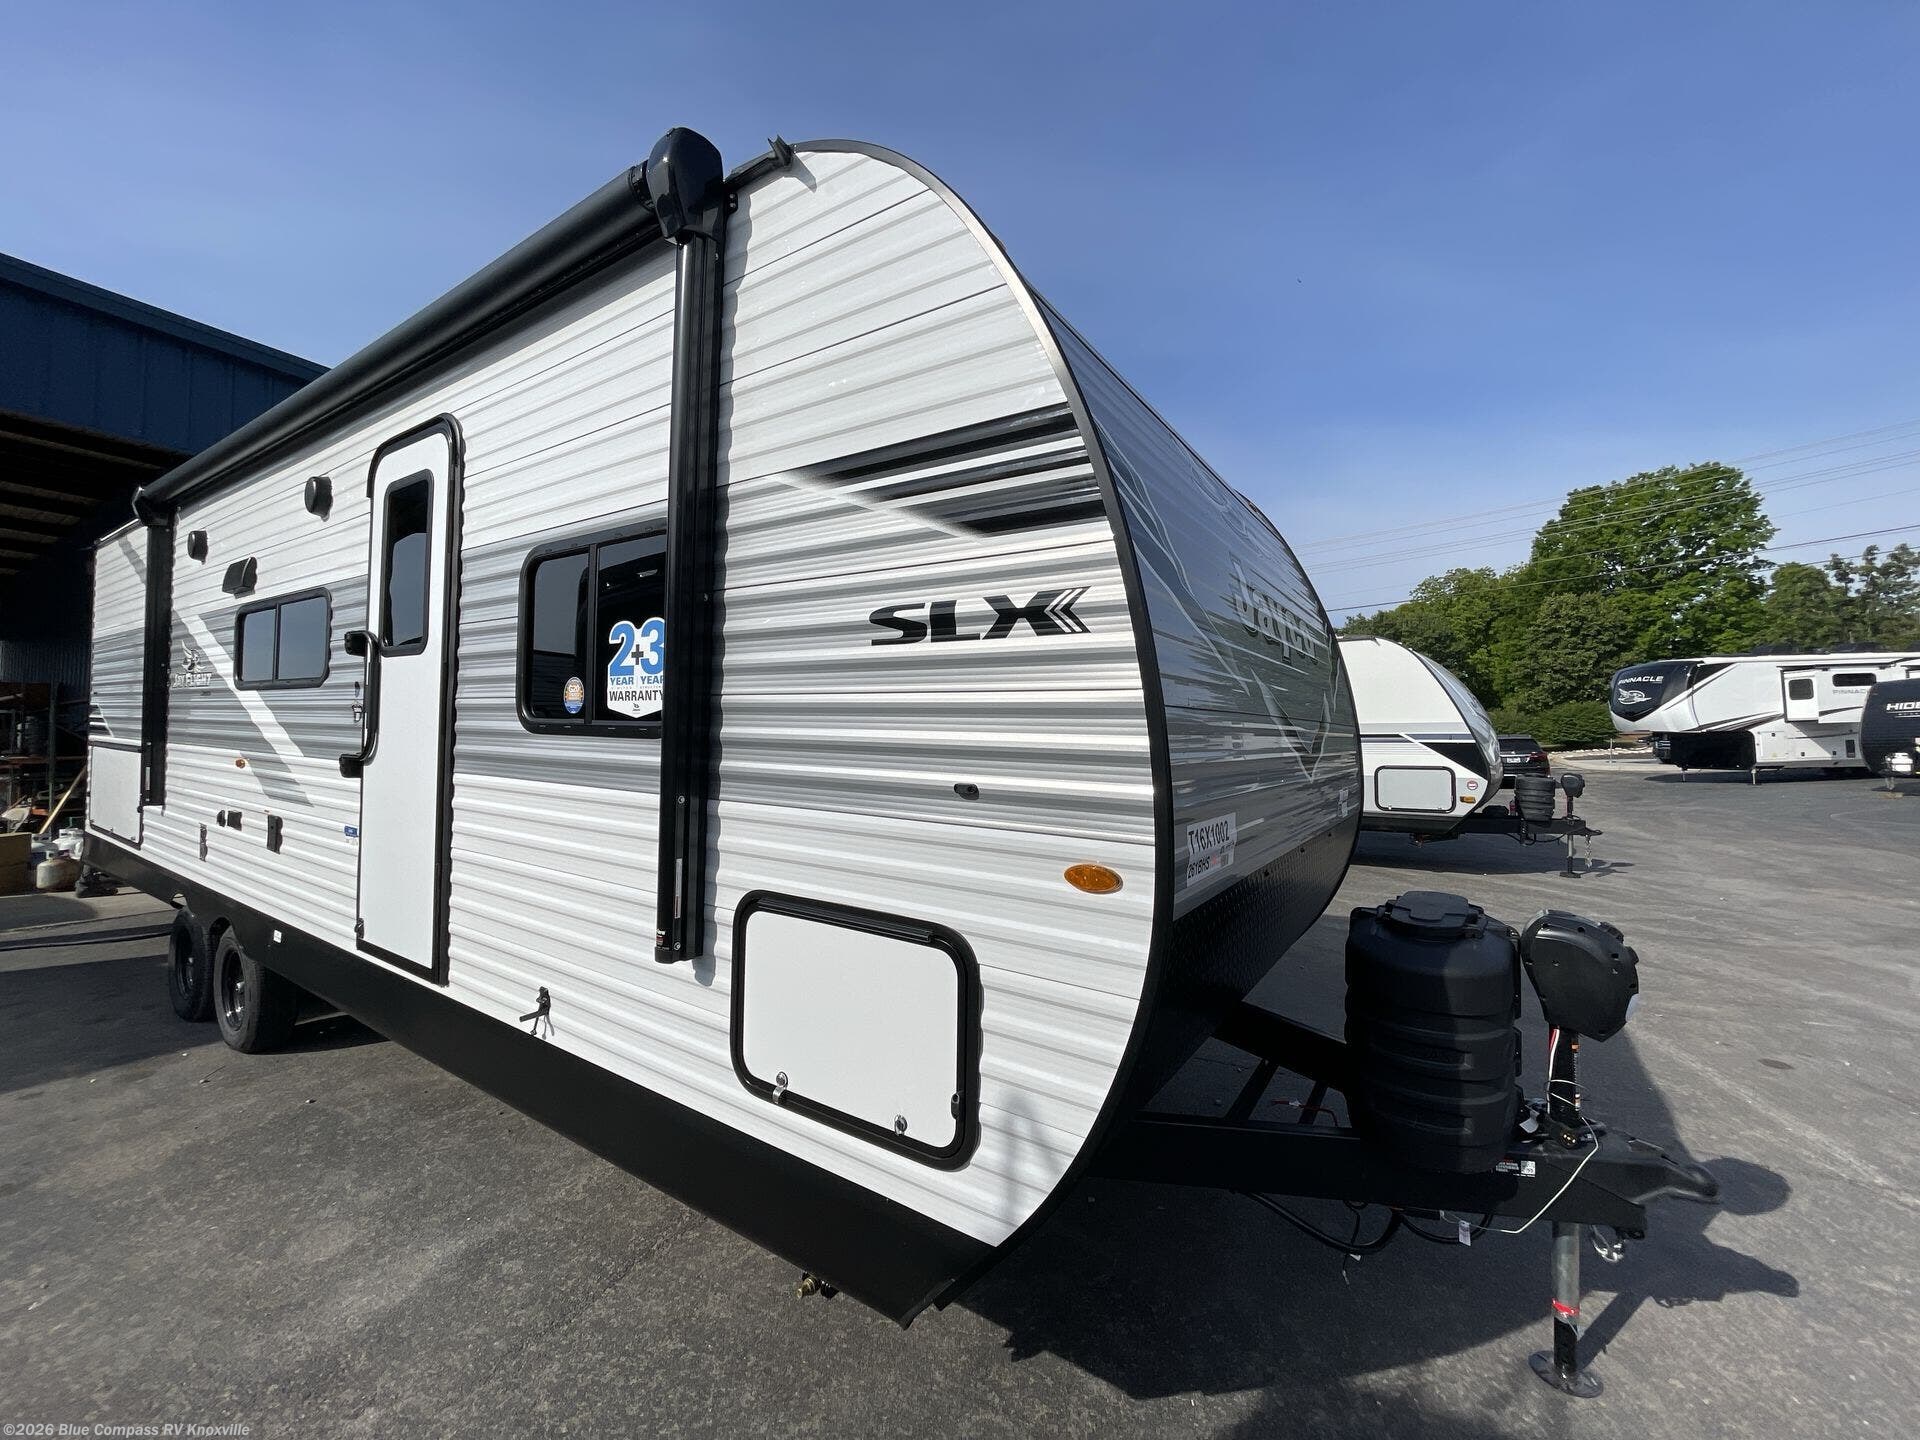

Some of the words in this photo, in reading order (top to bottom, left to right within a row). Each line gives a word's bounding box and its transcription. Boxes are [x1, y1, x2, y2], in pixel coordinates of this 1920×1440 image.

[869, 586, 1092, 646] SLX
[610, 676, 634, 686] YEAR
[1618, 675, 1664, 685] PINNACLE
[1188, 820, 1230, 855] T16X1002
